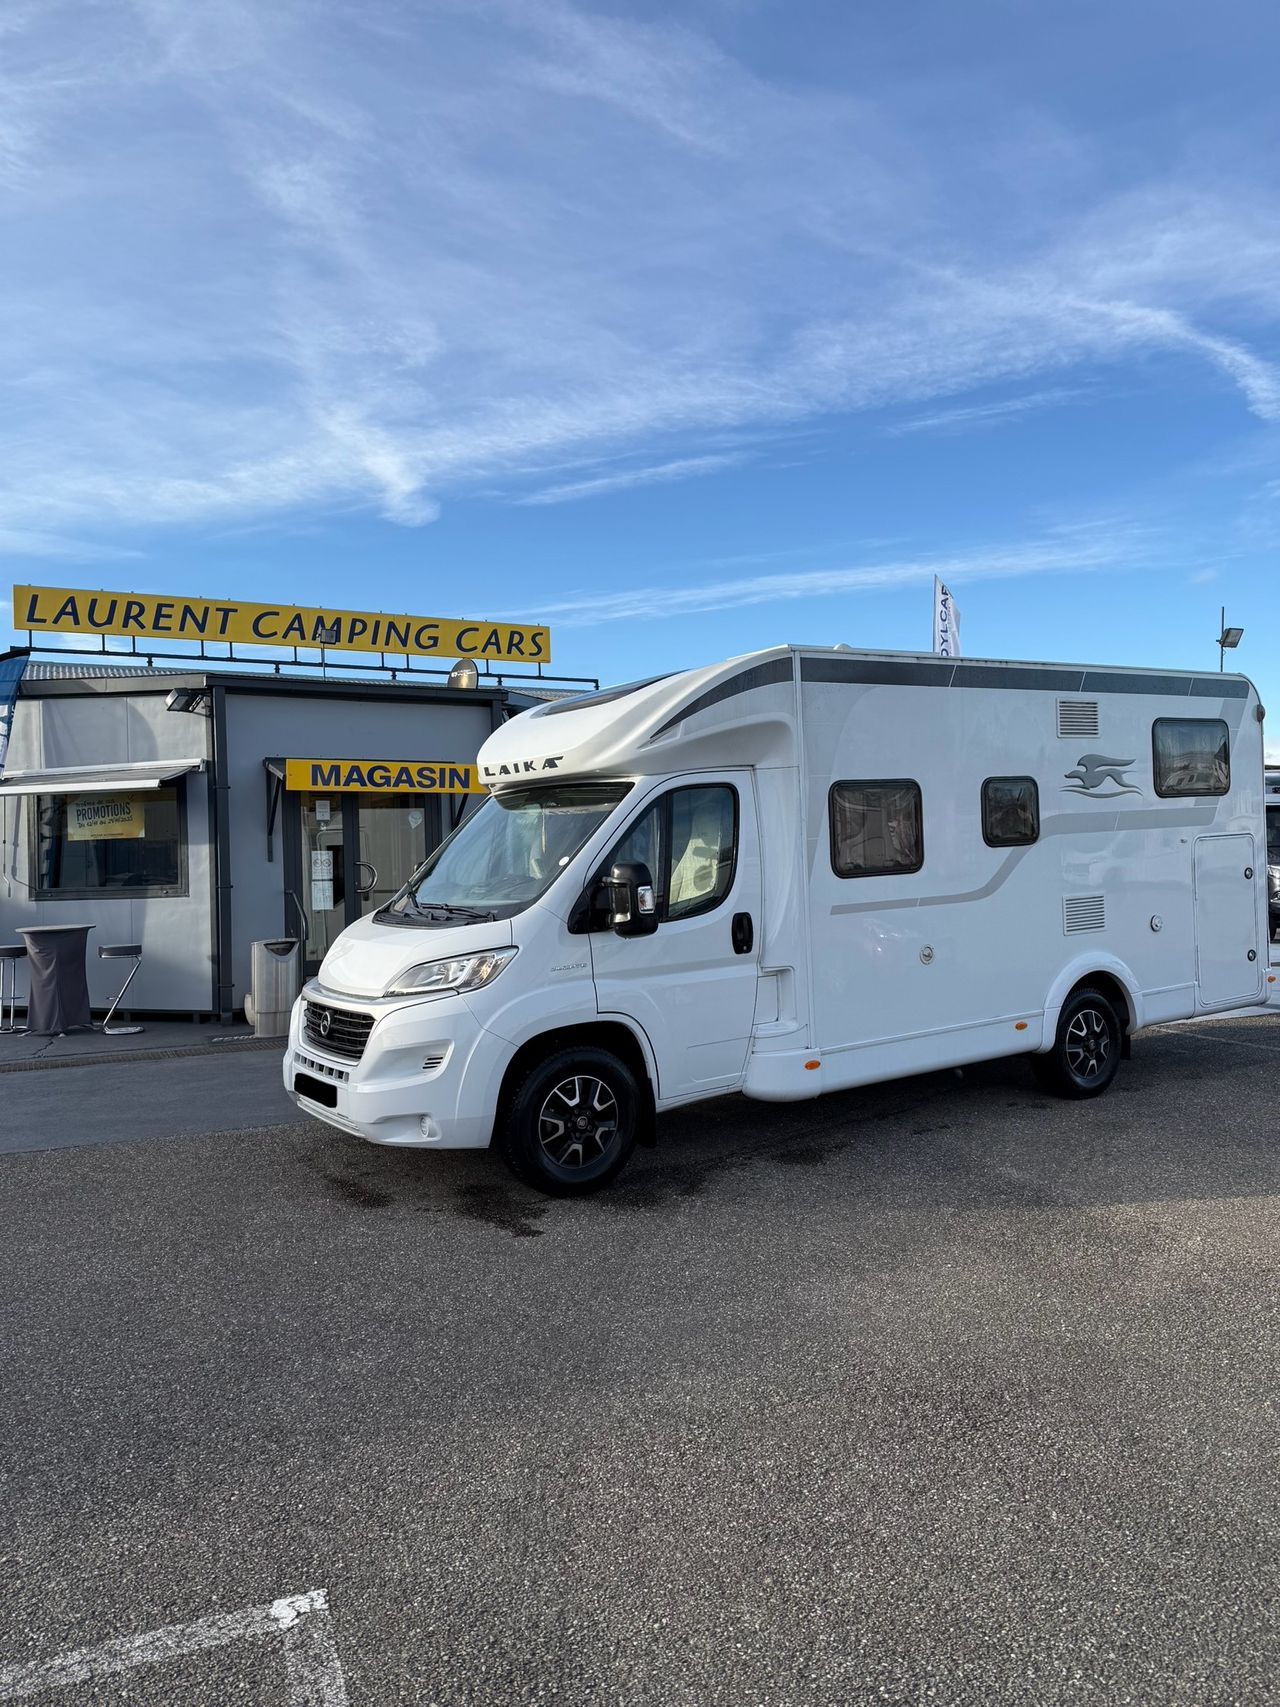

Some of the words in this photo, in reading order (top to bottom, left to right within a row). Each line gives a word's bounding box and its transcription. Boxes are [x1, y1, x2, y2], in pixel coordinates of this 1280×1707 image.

[26, 593, 238, 635] LAURENT
[252, 611, 440, 650] CAMPING
[455, 627, 544, 658] CARS
[311, 764, 471, 789] MAGASIN
[483, 756, 564, 776] LAIKA
[76, 802, 131, 821] PROMOTIONS
